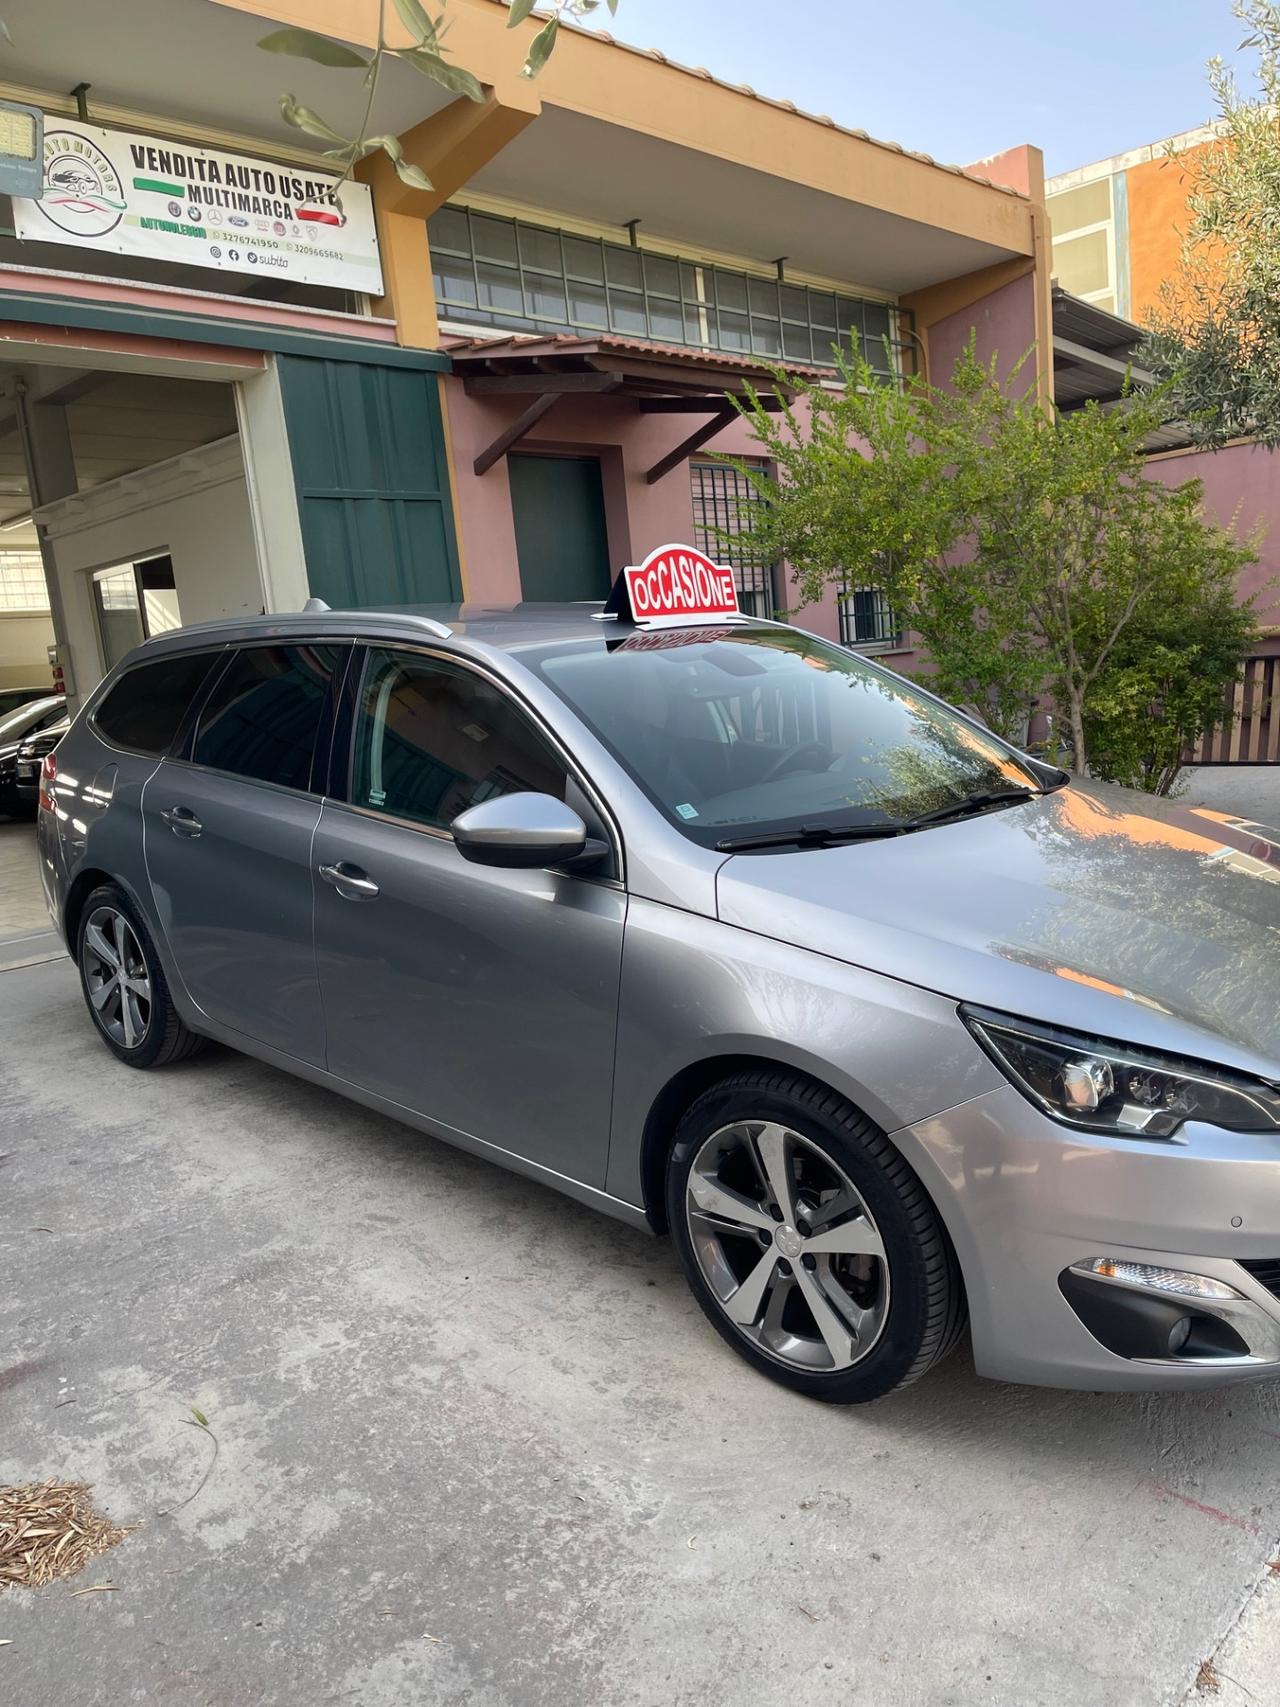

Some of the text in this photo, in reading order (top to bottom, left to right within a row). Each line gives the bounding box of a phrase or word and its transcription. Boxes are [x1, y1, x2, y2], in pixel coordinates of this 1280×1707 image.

[45, 138, 118, 192] UTO MOTORS
[130, 144, 222, 184] VENDITA
[225, 163, 276, 195] AUTO
[187, 184, 293, 220] MULTIMARCA
[222, 232, 279, 249] 3276741950
[259, 254, 289, 268] subito
[634, 555, 735, 610] OCCASIONE
